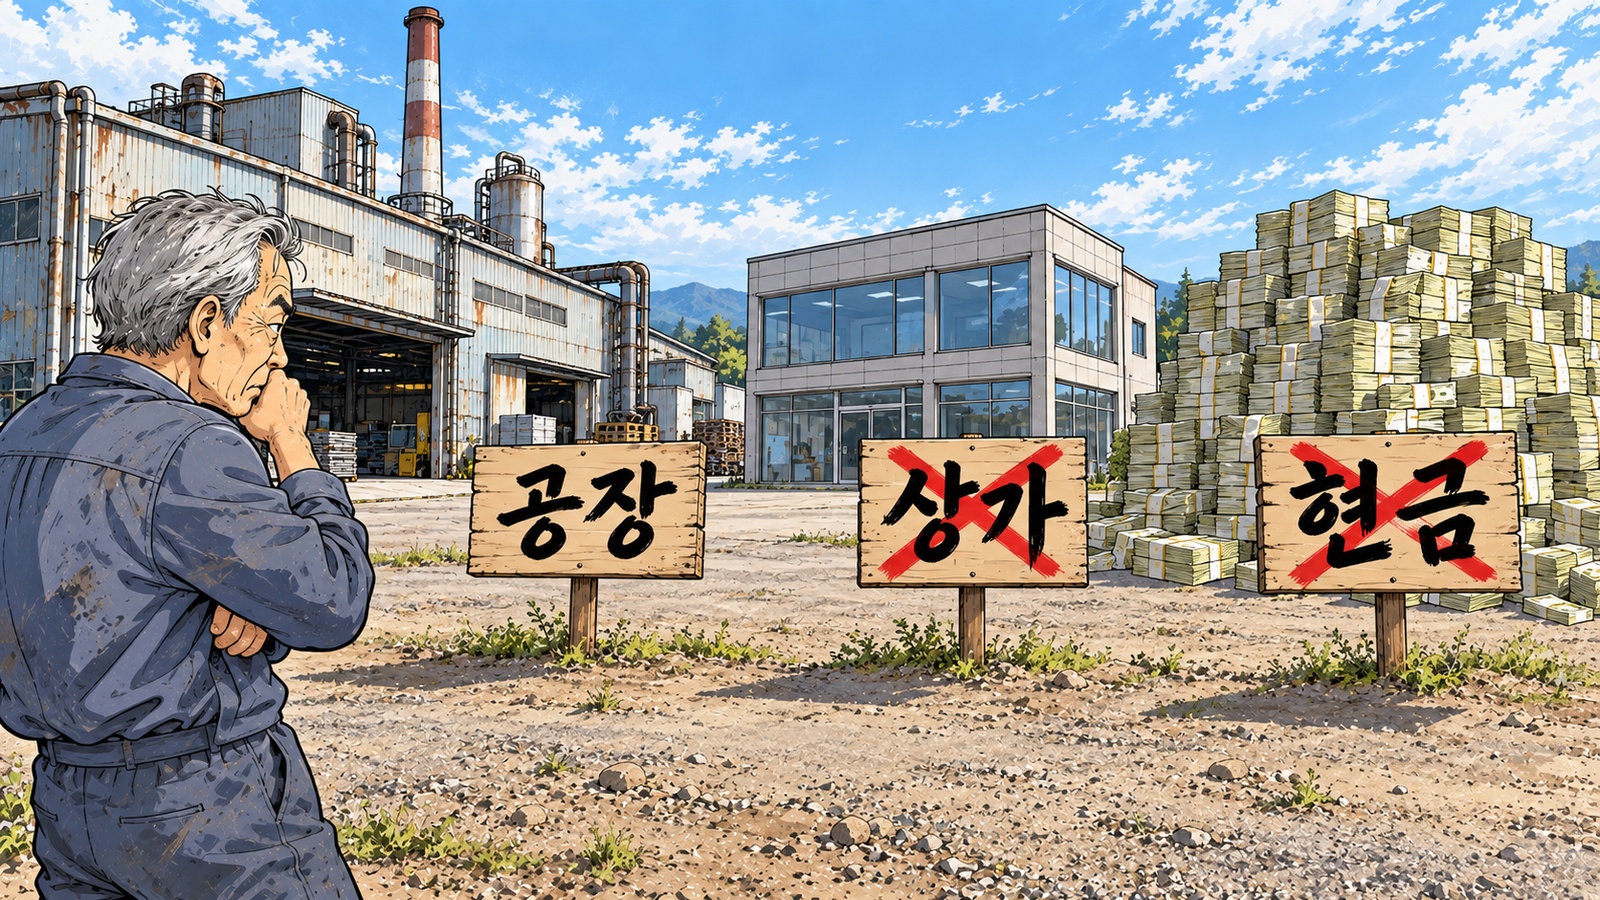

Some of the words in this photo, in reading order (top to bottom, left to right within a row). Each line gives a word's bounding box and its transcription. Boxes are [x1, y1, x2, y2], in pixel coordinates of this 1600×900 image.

[496, 459, 678, 562] 공장
[881, 460, 1069, 570] 상가
[1289, 457, 1490, 569] 현금
